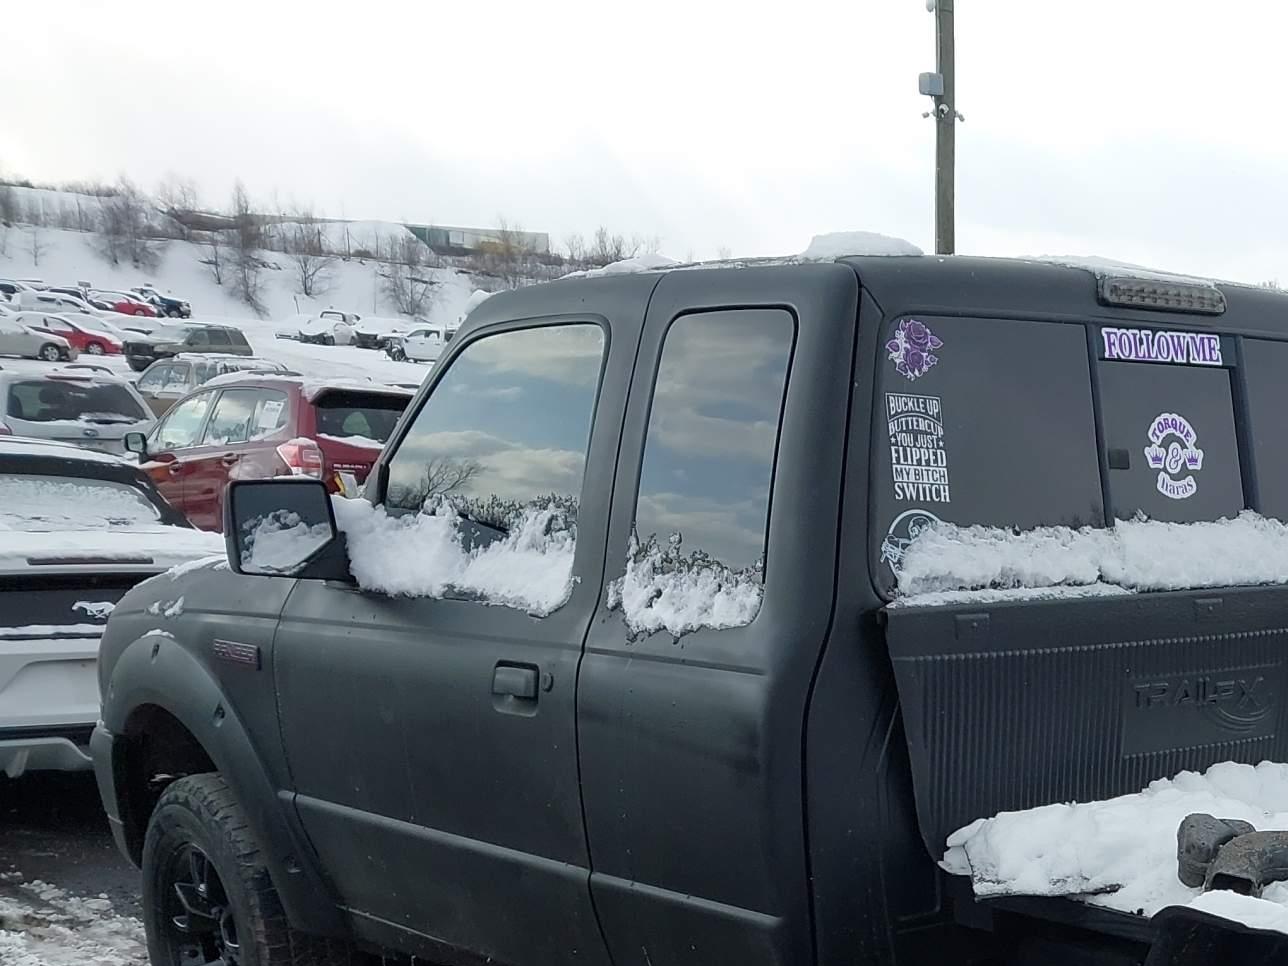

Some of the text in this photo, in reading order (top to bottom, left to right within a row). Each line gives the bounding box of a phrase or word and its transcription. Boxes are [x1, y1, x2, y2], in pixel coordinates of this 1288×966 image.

[1102, 327, 1222, 365] FOLLOW ME
[888, 396, 939, 417] BUCKLE UP
[889, 417, 943, 437] BUTTERCUP
[1151, 417, 1192, 443] TORQUE
[896, 433, 937, 448] YOU JUST
[891, 446, 947, 467] FLIPPED
[1169, 447, 1182, 471] &
[895, 467, 947, 484] MY BITCH
[895, 482, 950, 502] SWITCH
